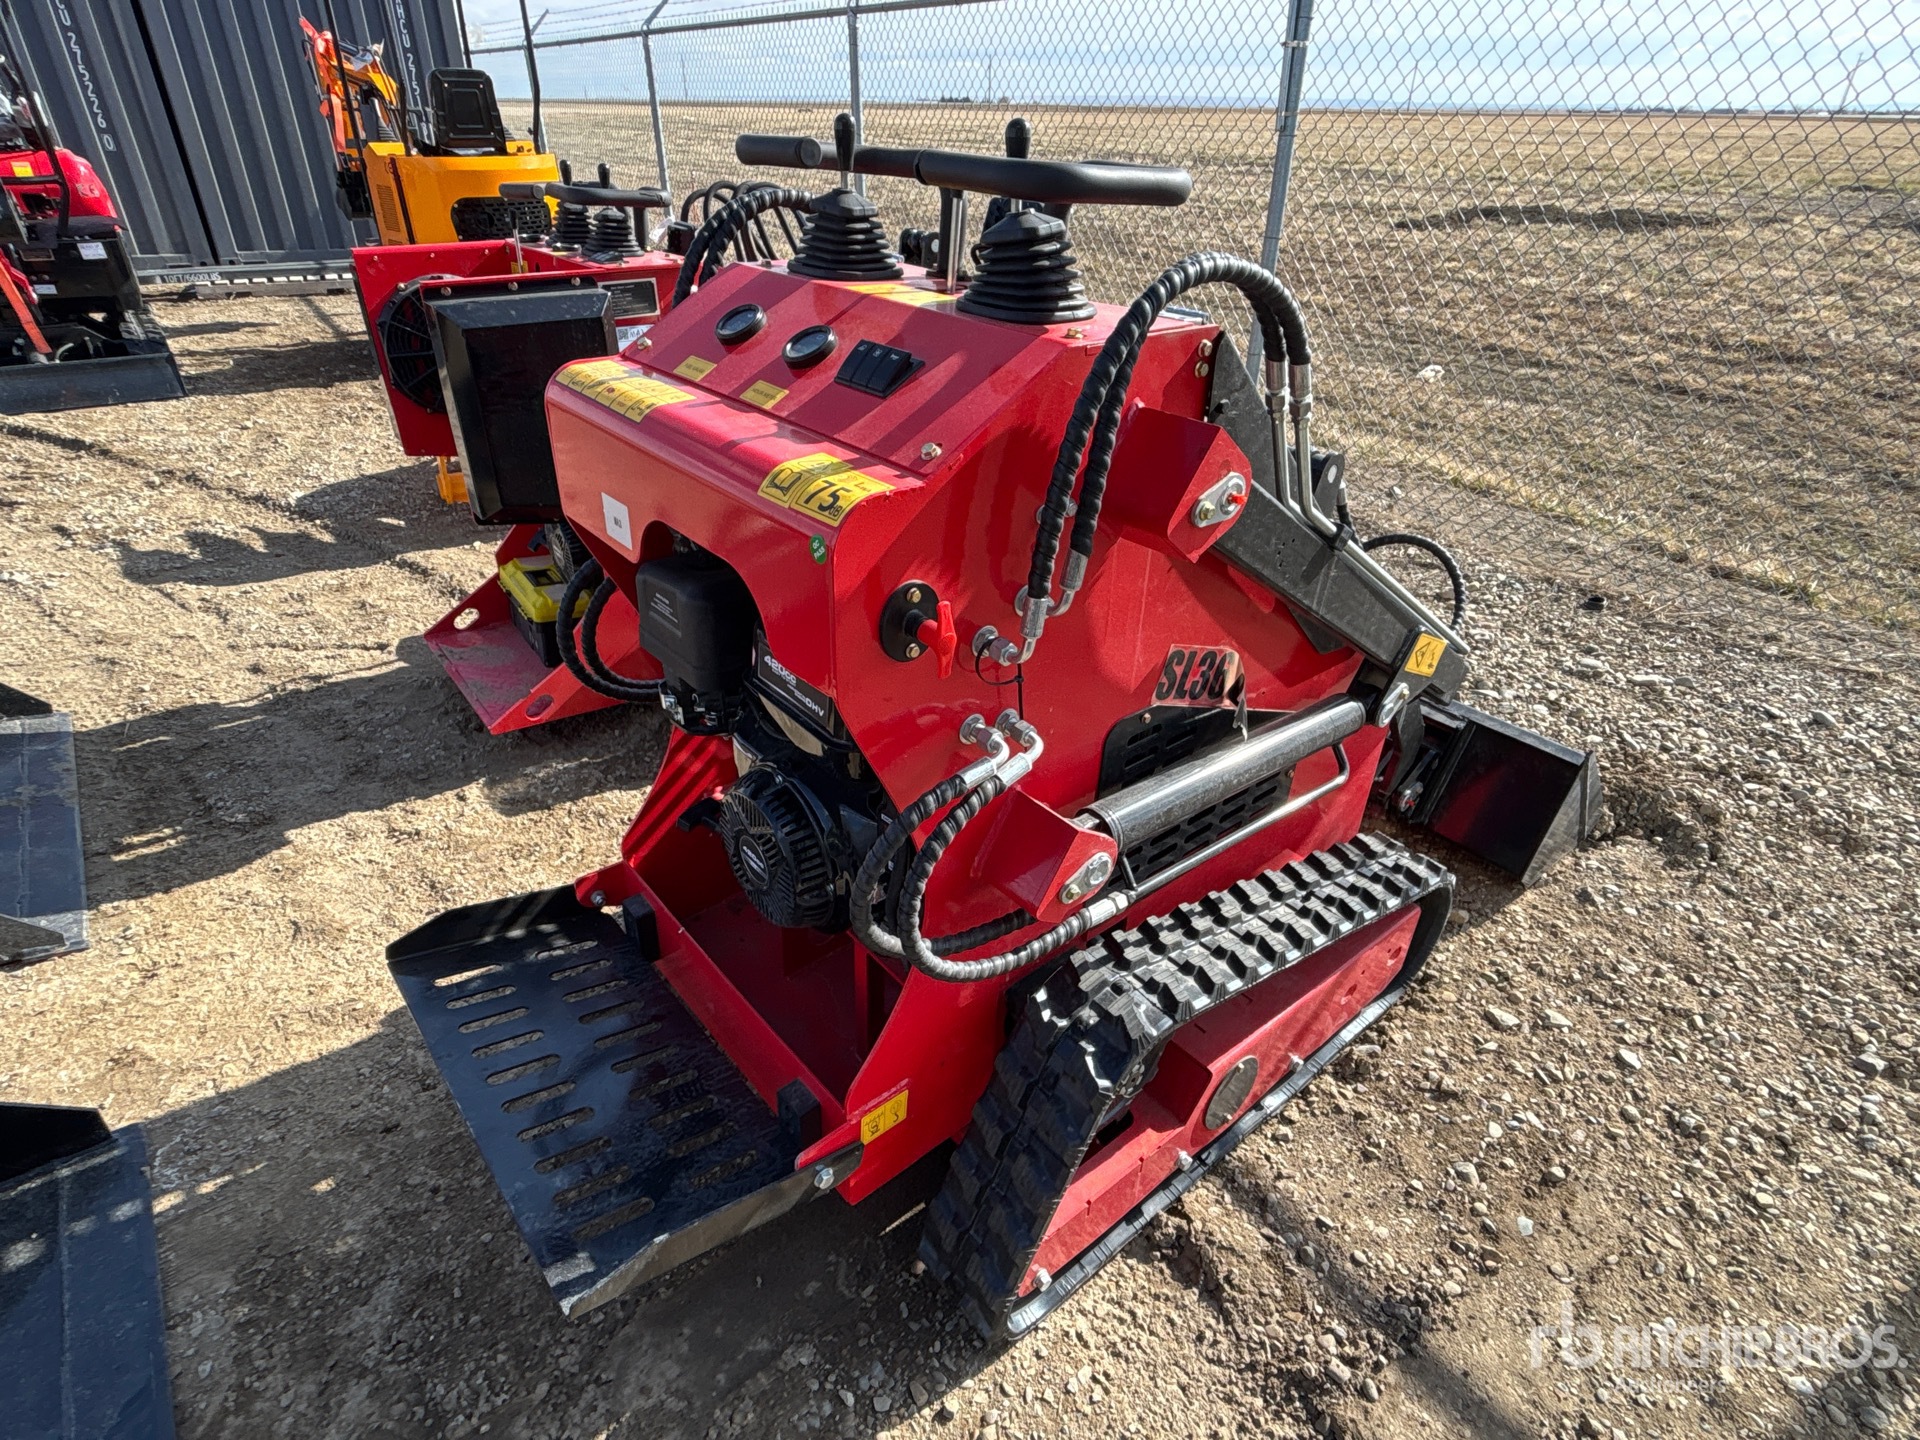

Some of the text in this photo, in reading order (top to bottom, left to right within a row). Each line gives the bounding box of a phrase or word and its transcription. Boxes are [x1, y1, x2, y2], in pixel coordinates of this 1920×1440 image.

[67, 32, 106, 128] 275226
[803, 480, 852, 518] 75 dB
[812, 540, 820, 549] QC
[813, 546, 825, 560] PASS
[805, 697, 825, 717] OHV
